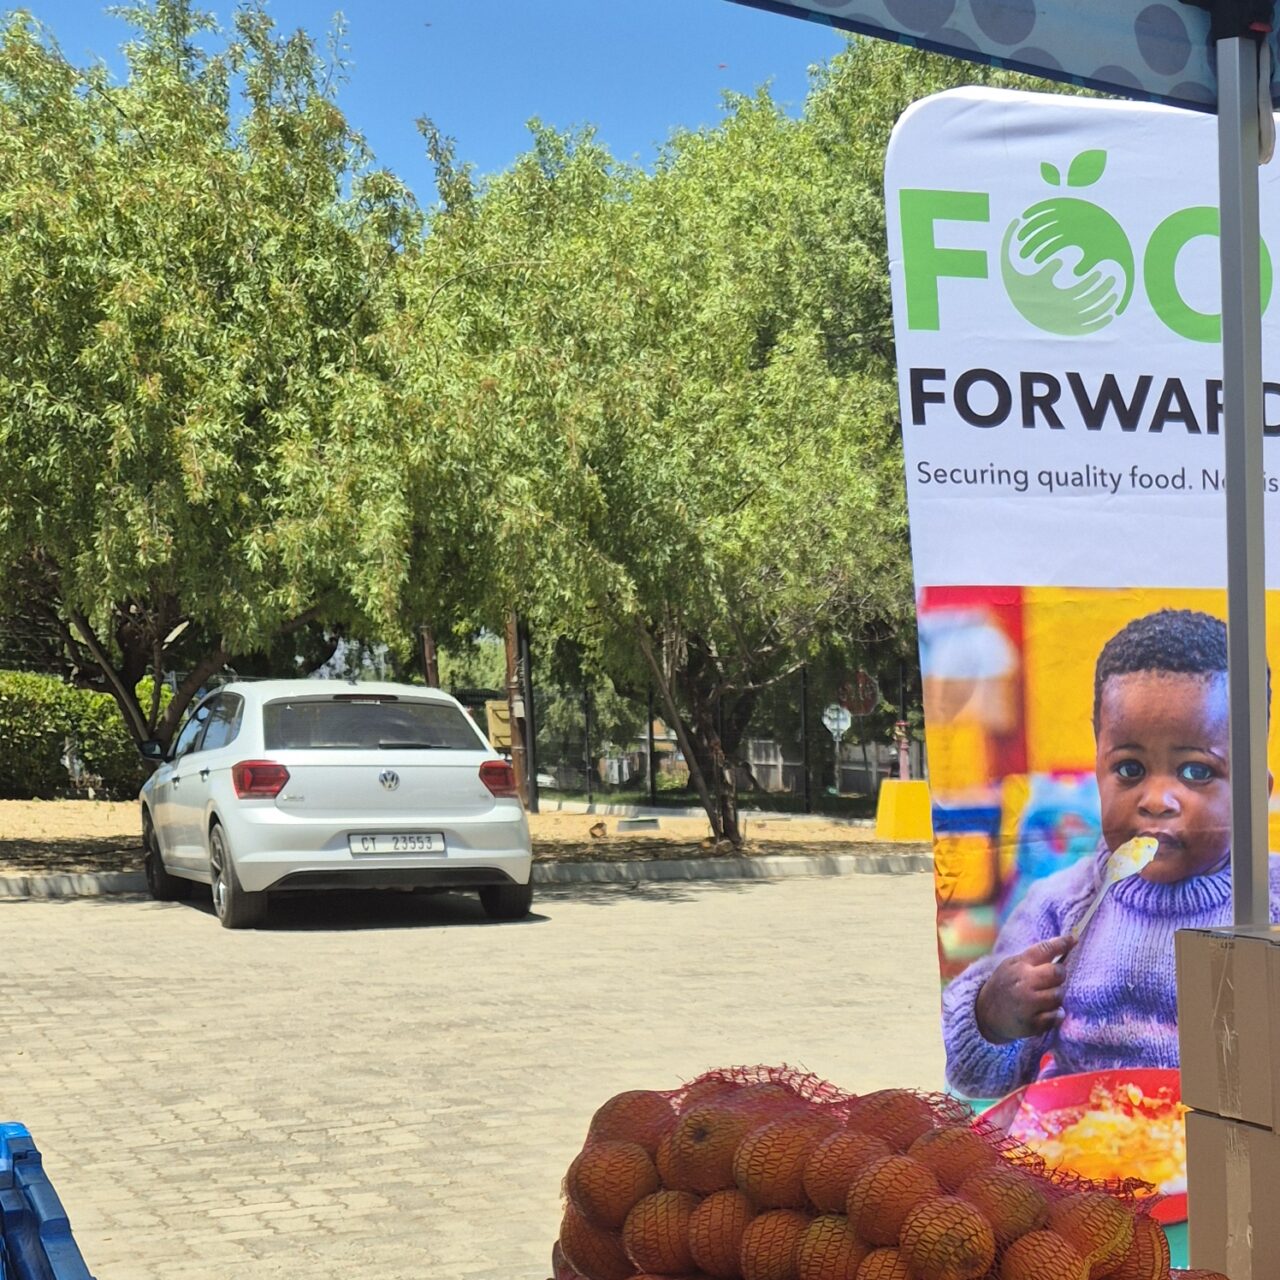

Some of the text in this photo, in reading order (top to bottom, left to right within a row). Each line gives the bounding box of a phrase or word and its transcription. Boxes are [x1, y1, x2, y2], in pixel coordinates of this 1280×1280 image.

[917, 461, 1029, 492] Securing
[1038, 465, 1122, 495] quality
[1130, 466, 1193, 491] food.
[361, 836, 433, 851] CT 23553
